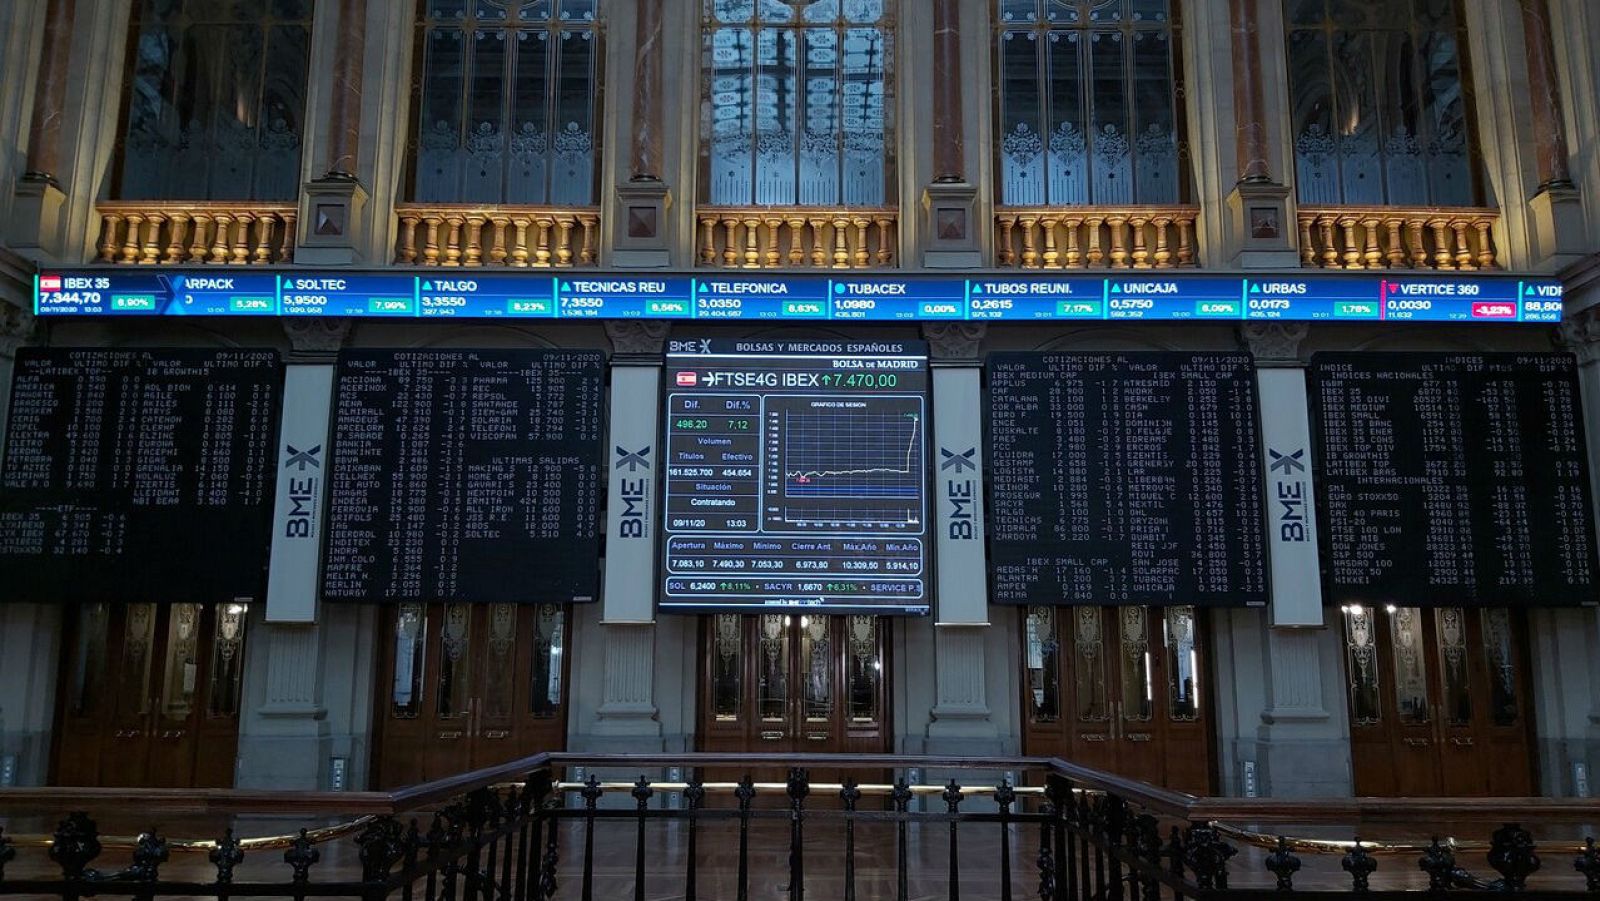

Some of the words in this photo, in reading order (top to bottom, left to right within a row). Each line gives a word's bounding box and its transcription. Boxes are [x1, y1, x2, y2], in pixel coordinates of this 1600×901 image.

[64, 278, 93, 289] IBEX
[95, 278, 110, 289] 35
[296, 279, 346, 290] SOLTEC
[434, 280, 478, 292] TALGO
[573, 281, 636, 293] TECNICAS
[639, 282, 666, 293] REU
[711, 282, 788, 294] TELEFONICA
[847, 283, 906, 294] TUBACEX
[985, 283, 1028, 294] TUBOS
[1030, 283, 1073, 294] REUNI.
[1123, 283, 1178, 294] UNICAJA
[1263, 283, 1306, 294] URBAS
[1401, 284, 1455, 295] VERTICE
[1457, 284, 1479, 295] 360
[39, 292, 101, 304] 7.344,70
[283, 295, 328, 306] 5,9500
[422, 296, 466, 308] 3,3550
[560, 297, 604, 308] 7,3550
[236, 299, 267, 308] 5,28%
[698, 299, 742, 309] 3,0350
[834, 300, 876, 310] 1,0980
[971, 300, 1013, 310] 0,2615
[1063, 304, 1094, 313] 7,17%
[1109, 299, 1153, 310] 0,5750
[1249, 299, 1290, 310] 0,0173
[1387, 301, 1432, 311] 0,0030
[924, 305, 956, 315] 0,00%
[669, 341, 697, 352] BME
[736, 343, 774, 352] BOLSAS
[778, 343, 785, 352] Y
[788, 343, 843, 353] MERCADOS
[847, 342, 903, 353] ESPAÑOLES
[393, 353, 463, 361] COTIZACIONES
[1042, 356, 1112, 364] COTIZACIONES
[347, 360, 377, 368] VALOR
[480, 361, 509, 369] VALOR
[832, 360, 864, 368] BOLSA
[878, 360, 919, 369] MADRID
[997, 364, 1026, 372] VALOR
[1048, 364, 1083, 372] ULTIMO
[1129, 364, 1158, 372] VALOR
[714, 372, 778, 387] FTSE4G
[783, 373, 819, 387] IBEX
[833, 374, 897, 389] 7.470,00
[992, 395, 1039, 403] CATALANA
[684, 400, 701, 409] Dif.
[725, 400, 751, 410] Dif.%
[471, 424, 517, 432] TELEFONI
[676, 420, 708, 429] 496.20
[728, 420, 748, 430] 7.12
[697, 437, 732, 445] Volumen
[492, 457, 533, 465] ULTIMAS
[539, 456, 580, 465] SALIDAS
[721, 453, 753, 461] Efectivo
[669, 468, 713, 476] 161.525.700
[722, 468, 752, 477] 454.654
[690, 498, 736, 506] Contratando
[286, 477, 313, 538] BME
[620, 478, 644, 538] BME
[948, 480, 973, 540] BME
[1277, 481, 1304, 542] BME
[673, 519, 706, 527] 09/11/20
[726, 520, 747, 528] 13:03
[464, 530, 501, 538] SOLTEC
[671, 542, 706, 551] Apertura
[669, 582, 686, 590] SOL
[690, 582, 716, 591] 6,2400
[325, 589, 368, 597] NATURGY
